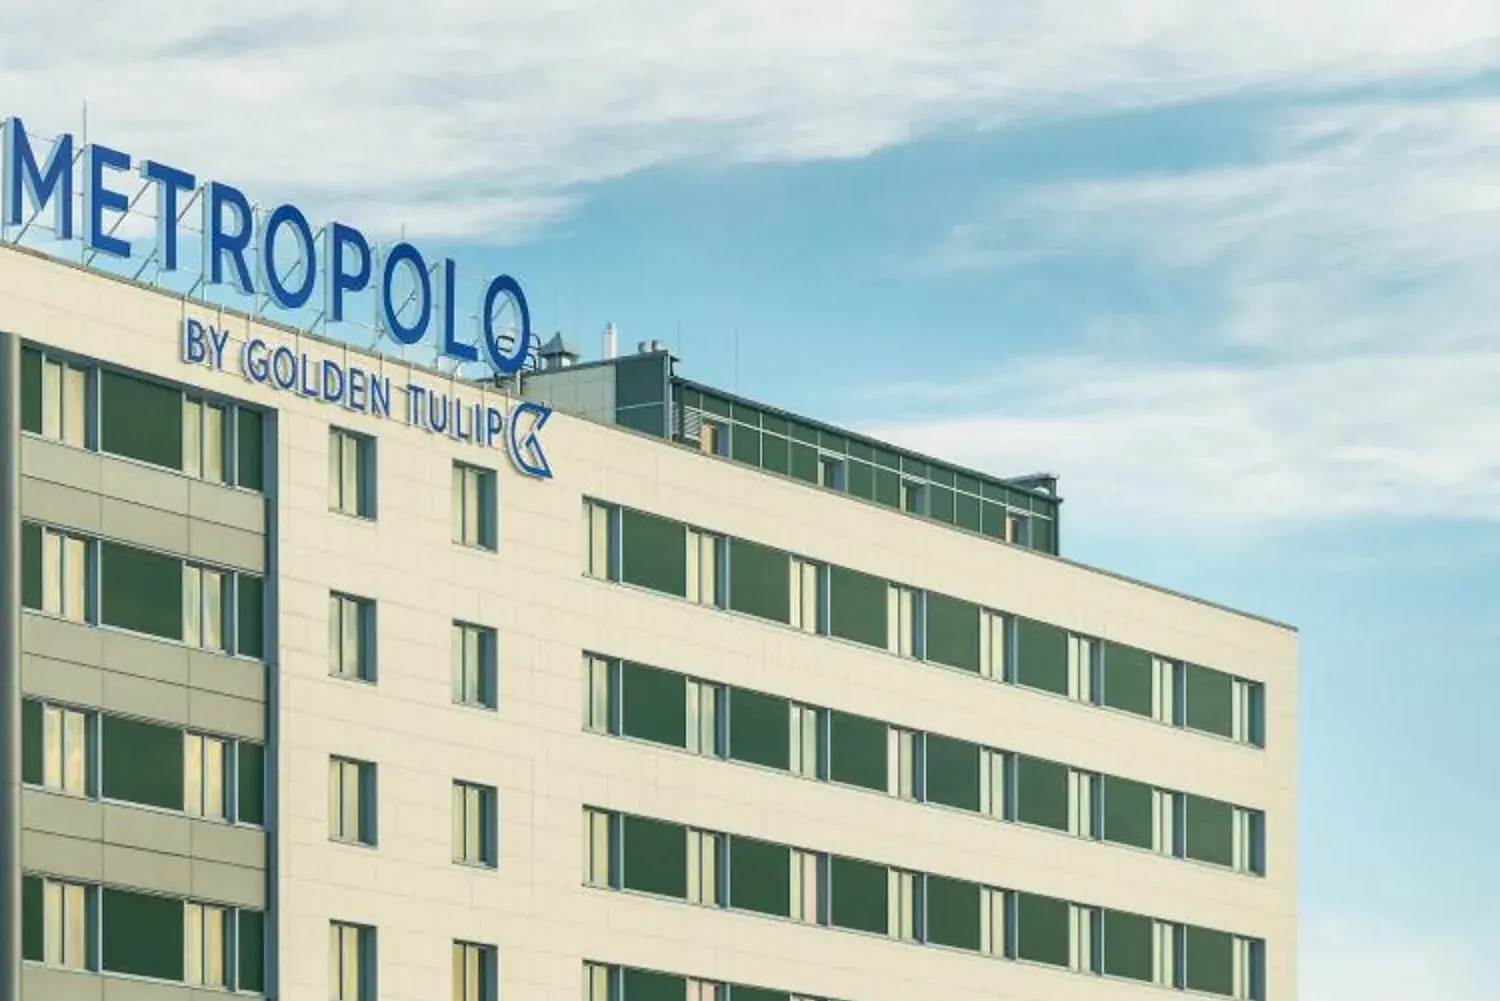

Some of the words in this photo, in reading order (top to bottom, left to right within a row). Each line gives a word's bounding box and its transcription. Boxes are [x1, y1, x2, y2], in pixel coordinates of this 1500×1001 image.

[2, 115, 531, 375] METROPOLO
[183, 317, 229, 371] BY
[242, 338, 391, 418] GOLDEN
[405, 382, 501, 449] TULIP
